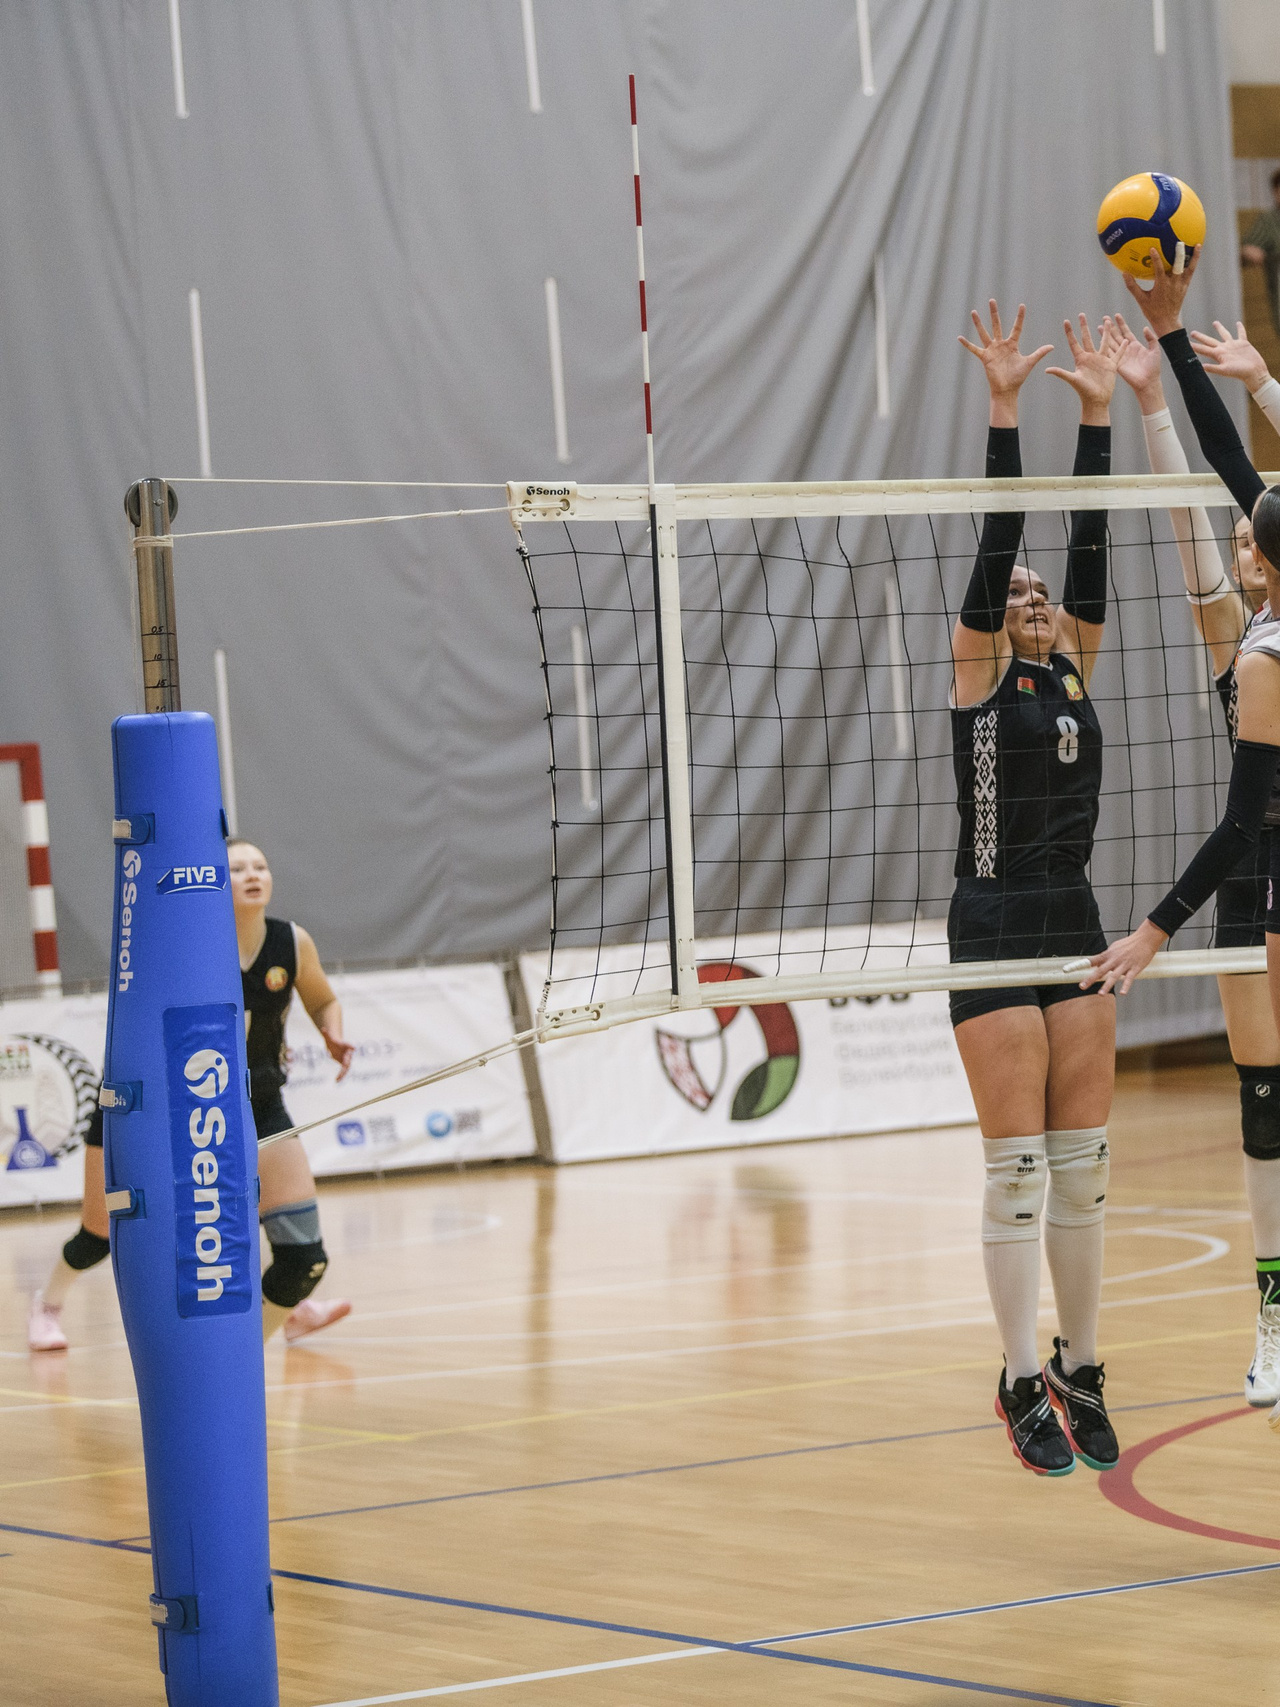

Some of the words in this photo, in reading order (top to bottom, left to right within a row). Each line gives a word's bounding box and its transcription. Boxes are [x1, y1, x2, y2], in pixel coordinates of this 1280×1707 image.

[536, 487, 570, 496] Senoh
[1056, 715, 1079, 764] 8
[173, 866, 217, 885] FIVB
[118, 881, 138, 992] Senoh
[189, 1106, 233, 1302] Senoh
